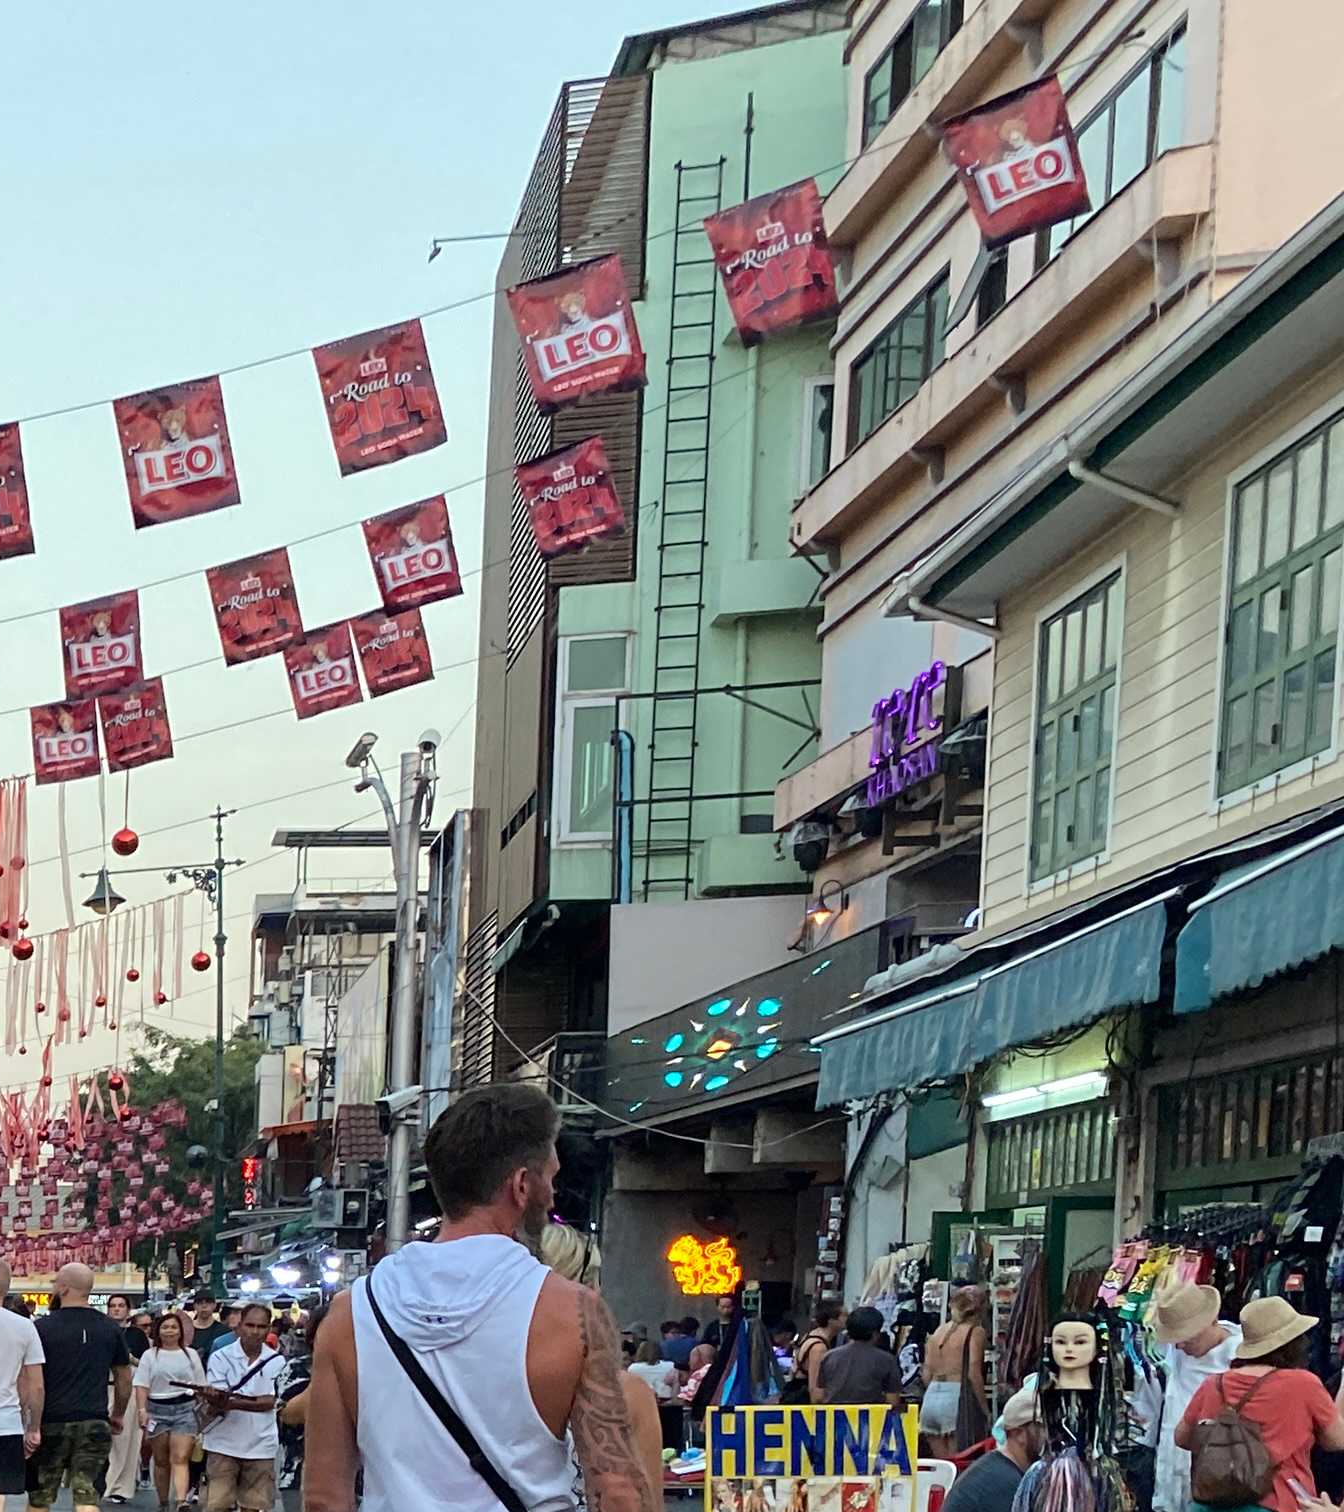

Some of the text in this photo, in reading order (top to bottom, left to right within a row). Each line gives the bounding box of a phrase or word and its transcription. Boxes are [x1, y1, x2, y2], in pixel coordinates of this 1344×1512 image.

[986, 151, 1065, 199] LEO
[742, 232, 812, 270] Road to
[543, 323, 620, 369] LEO
[345, 370, 412, 401] Road to
[145, 445, 214, 484] LEO
[389, 549, 444, 582] LEO
[76, 643, 129, 670] LEO
[710, 1406, 912, 1478] HENNA
